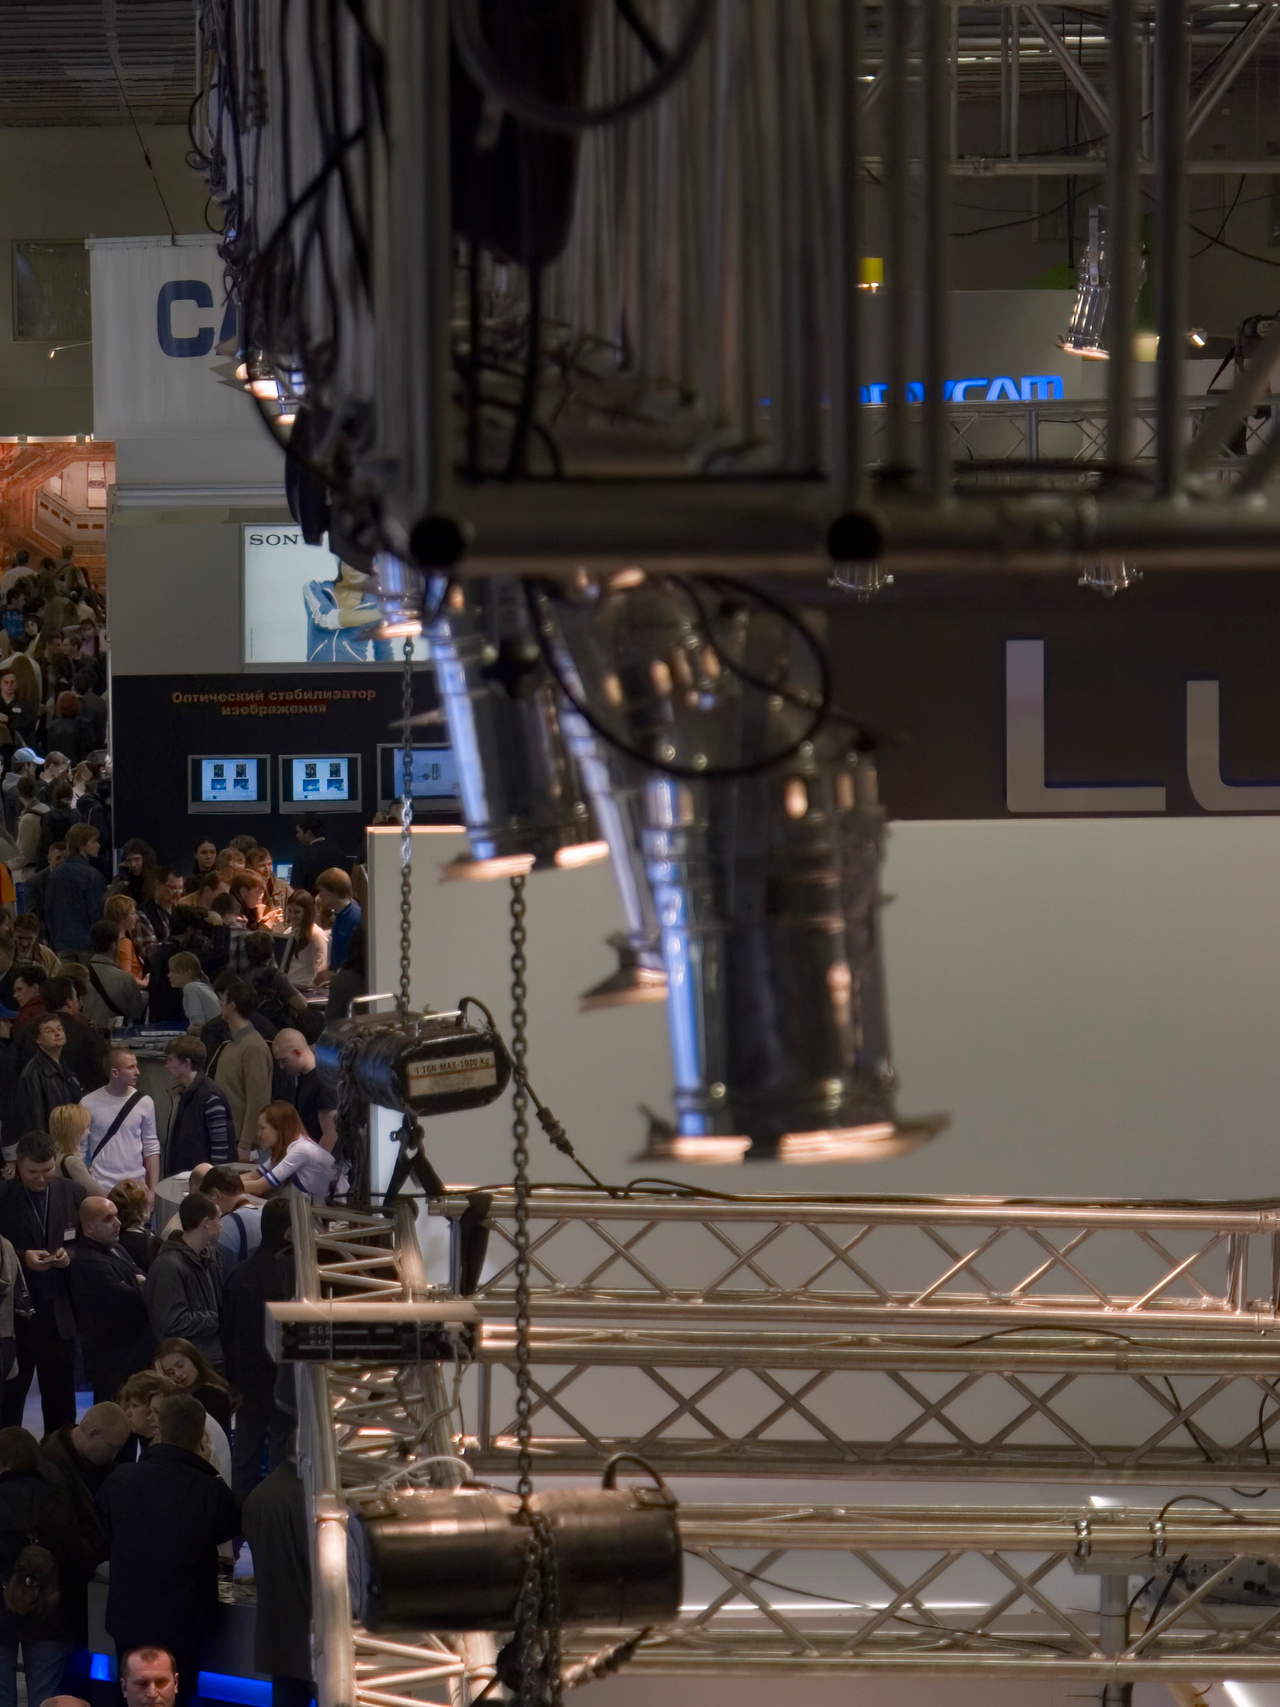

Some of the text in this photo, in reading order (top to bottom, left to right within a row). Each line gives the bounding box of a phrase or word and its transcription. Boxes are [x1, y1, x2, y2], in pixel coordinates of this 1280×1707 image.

[250, 534, 303, 546] SON
[172, 689, 376, 703] Оптический стабилизатор
[221, 704, 326, 717] изображения
